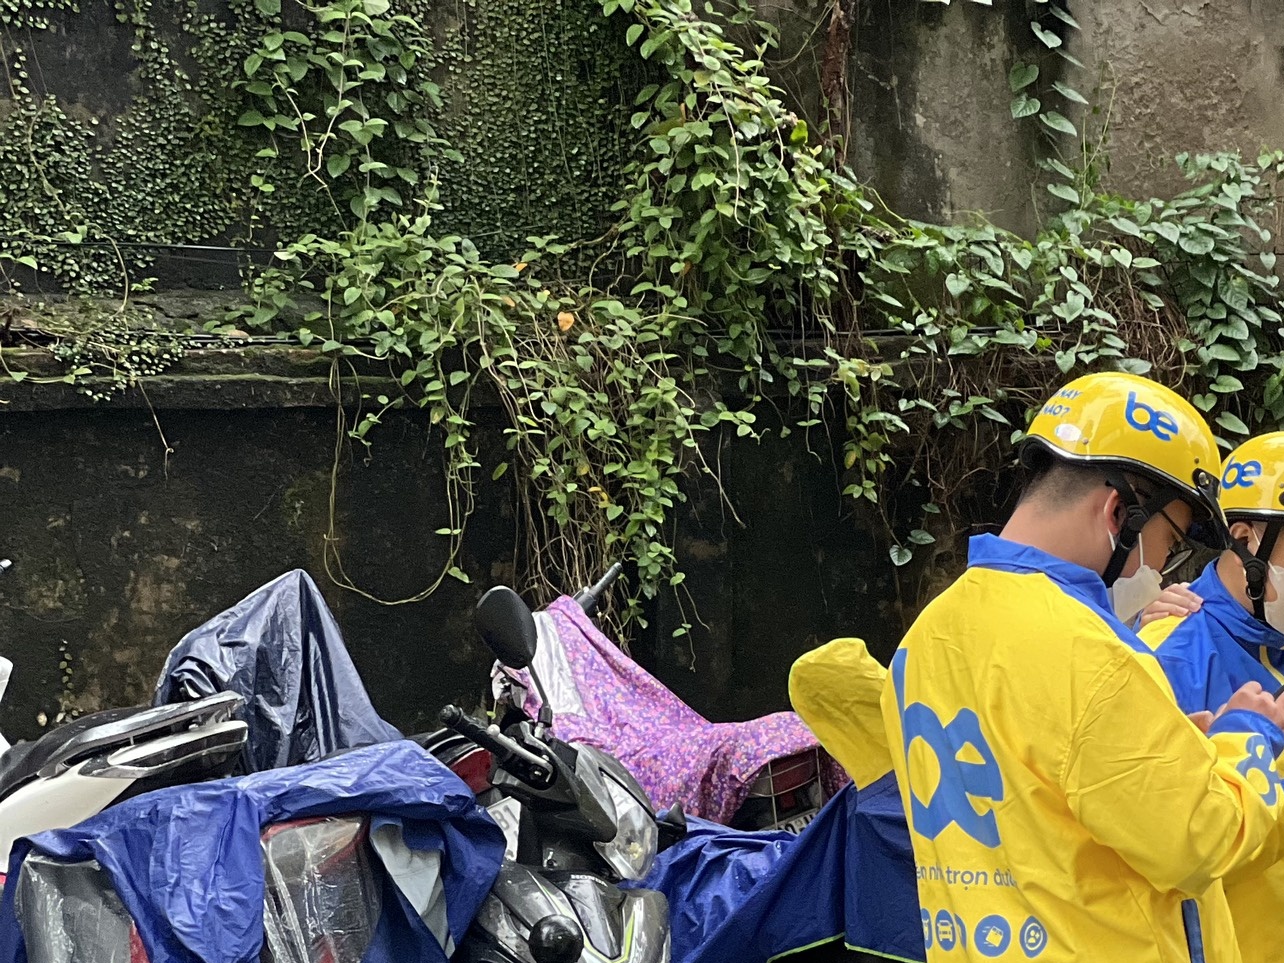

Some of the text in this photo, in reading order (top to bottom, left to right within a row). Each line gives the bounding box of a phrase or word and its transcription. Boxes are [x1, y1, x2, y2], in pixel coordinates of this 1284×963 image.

[1125, 390, 1179, 442] be
[1221, 455, 1262, 490] be
[892, 647, 1004, 848] be
[946, 866, 989, 891] trọn
